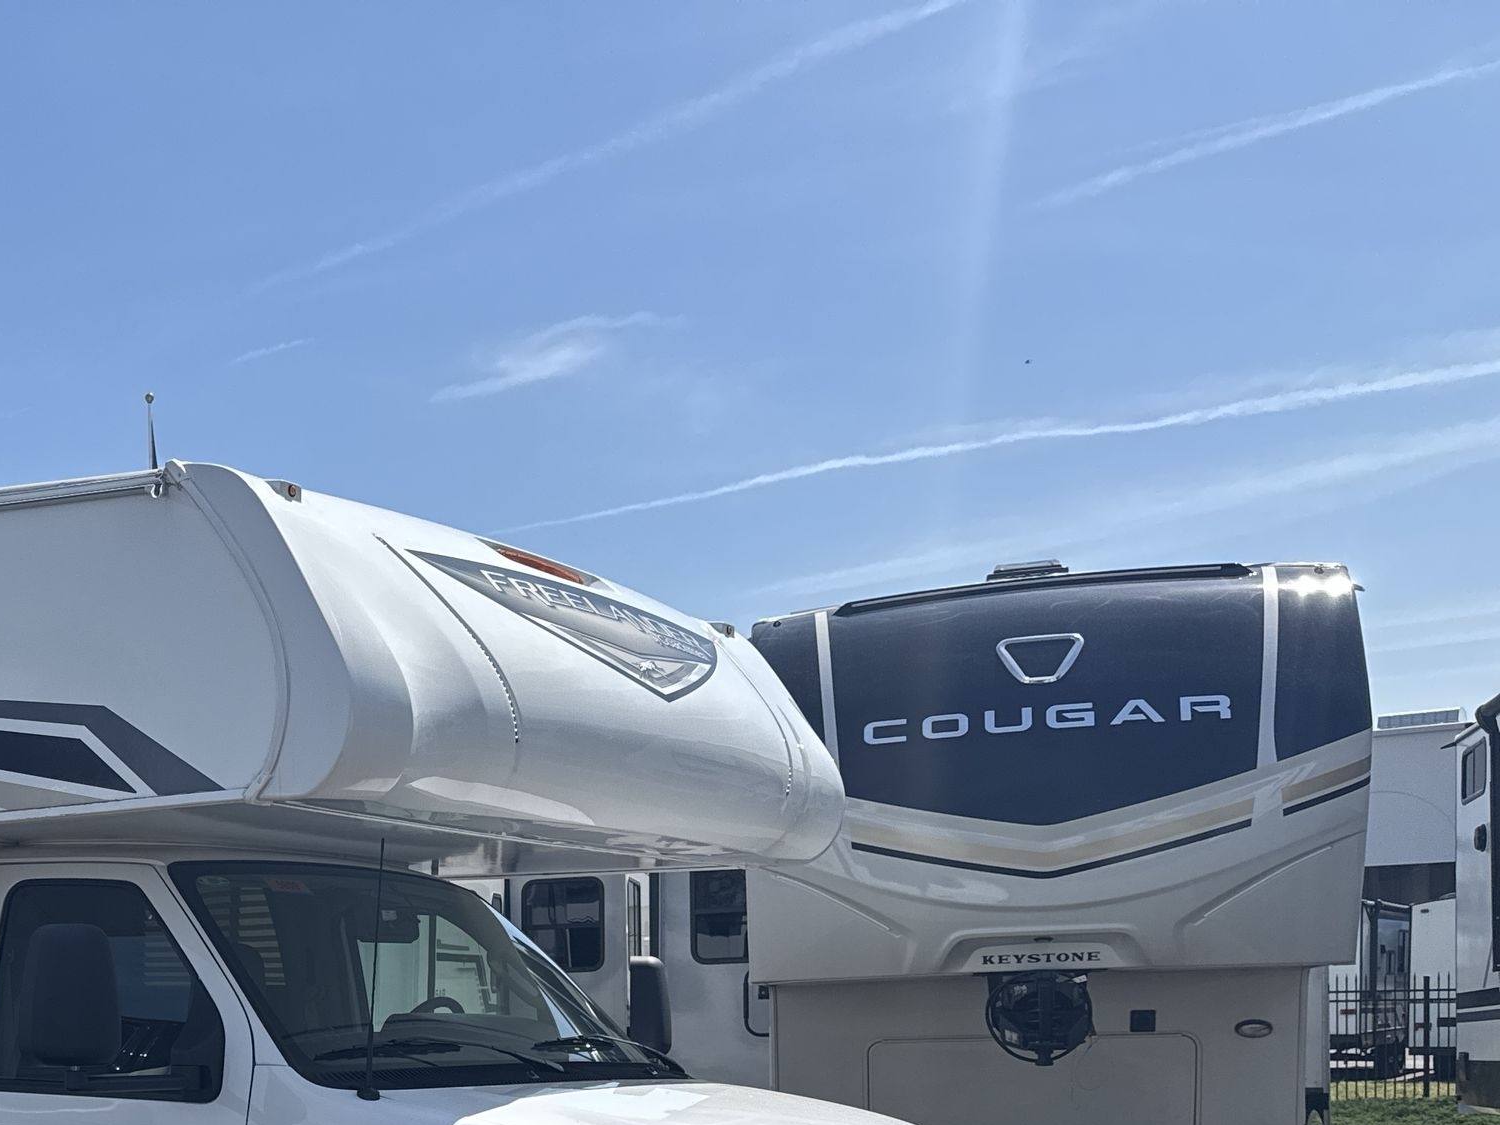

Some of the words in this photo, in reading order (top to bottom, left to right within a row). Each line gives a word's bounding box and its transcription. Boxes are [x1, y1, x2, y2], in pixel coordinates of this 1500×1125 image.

[480, 569, 714, 659] FREELANDER
[863, 694, 1232, 746] COUGAR
[981, 951, 1101, 965] KEYSTONE
